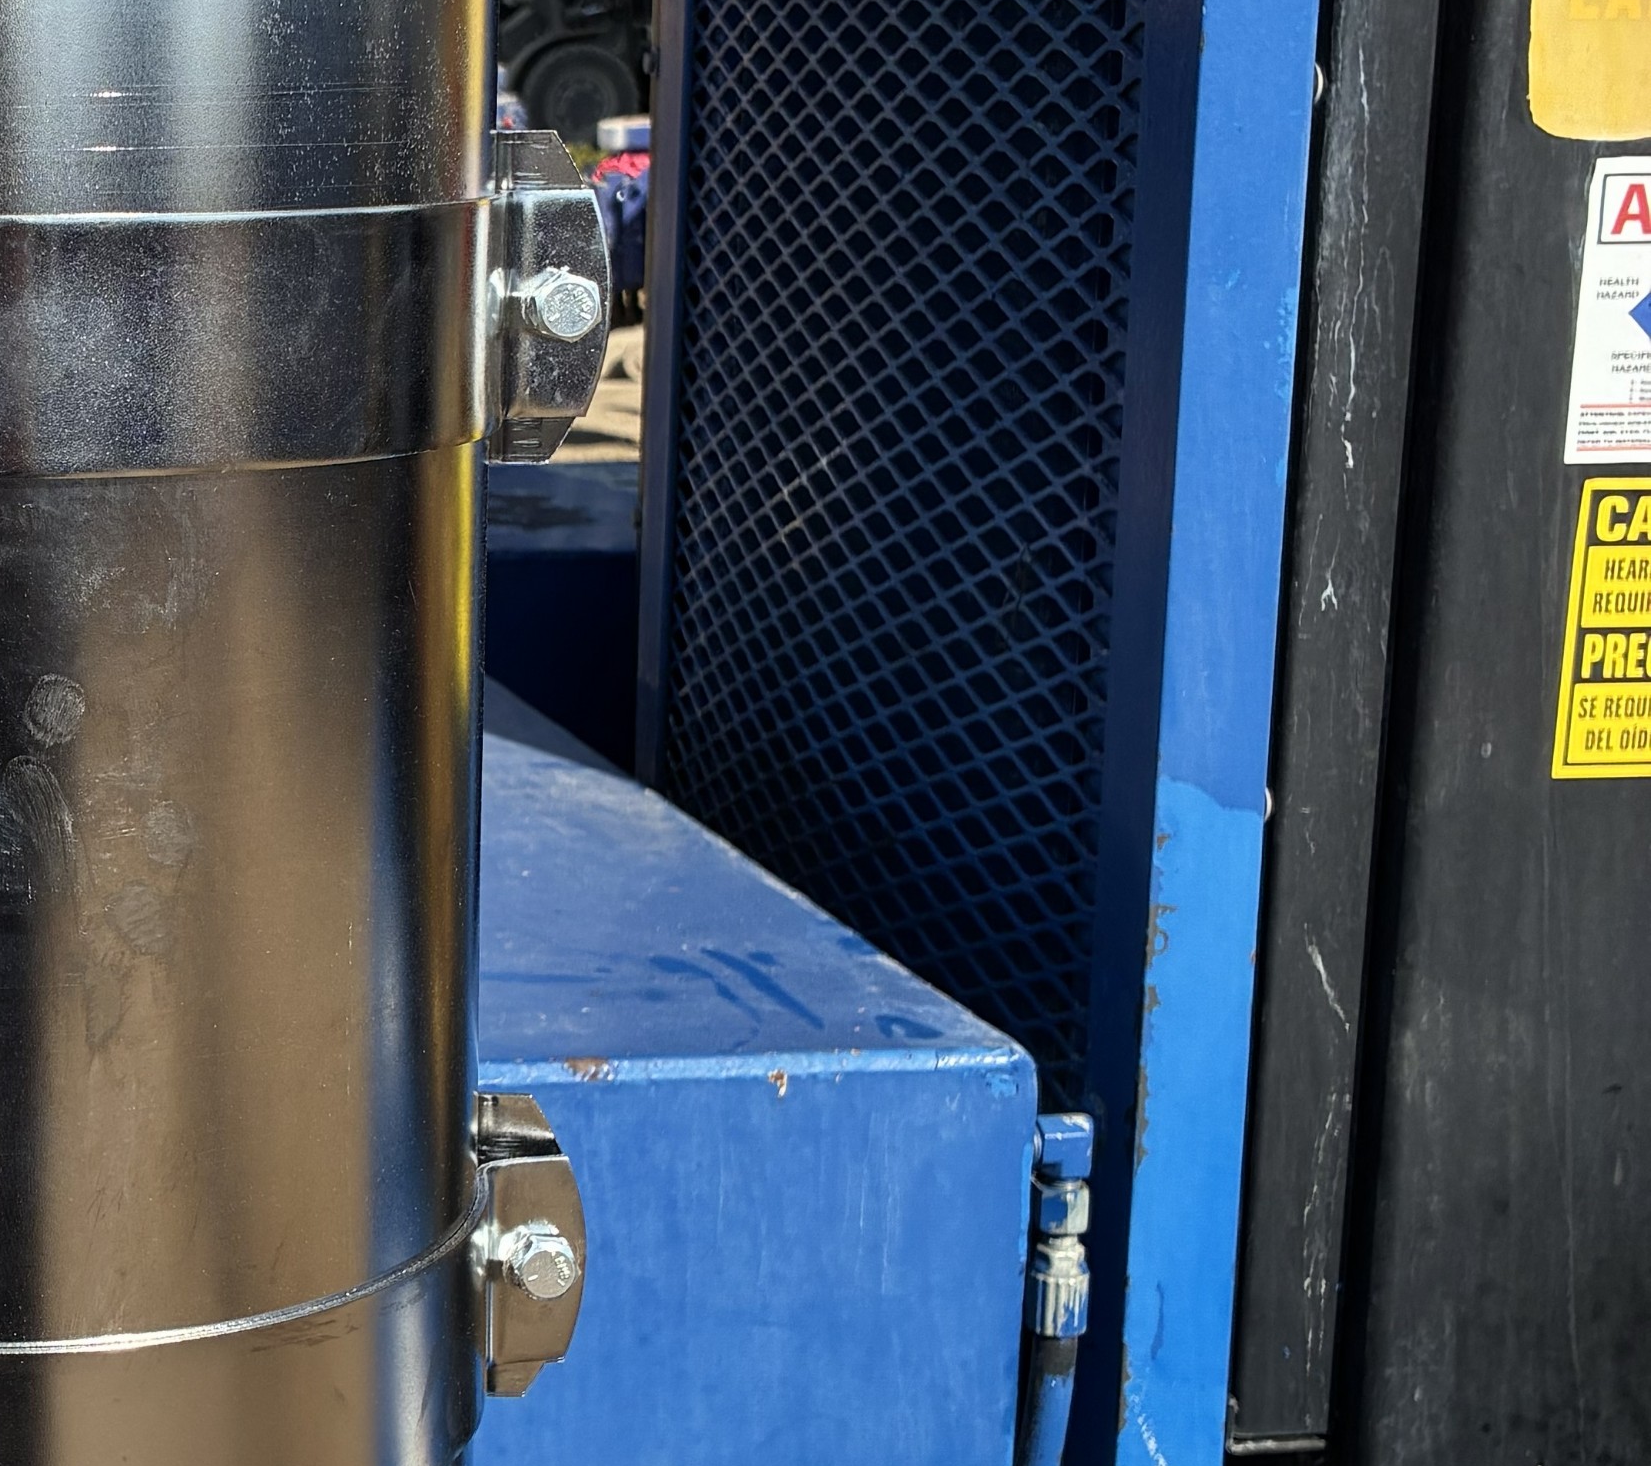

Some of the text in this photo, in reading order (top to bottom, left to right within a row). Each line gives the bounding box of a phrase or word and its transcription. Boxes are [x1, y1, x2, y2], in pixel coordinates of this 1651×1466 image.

[1603, 557, 1651, 581] HEAR
[1580, 632, 1651, 680] PRE
[1577, 695, 1598, 719] SE
[1584, 728, 1614, 752] DEL
